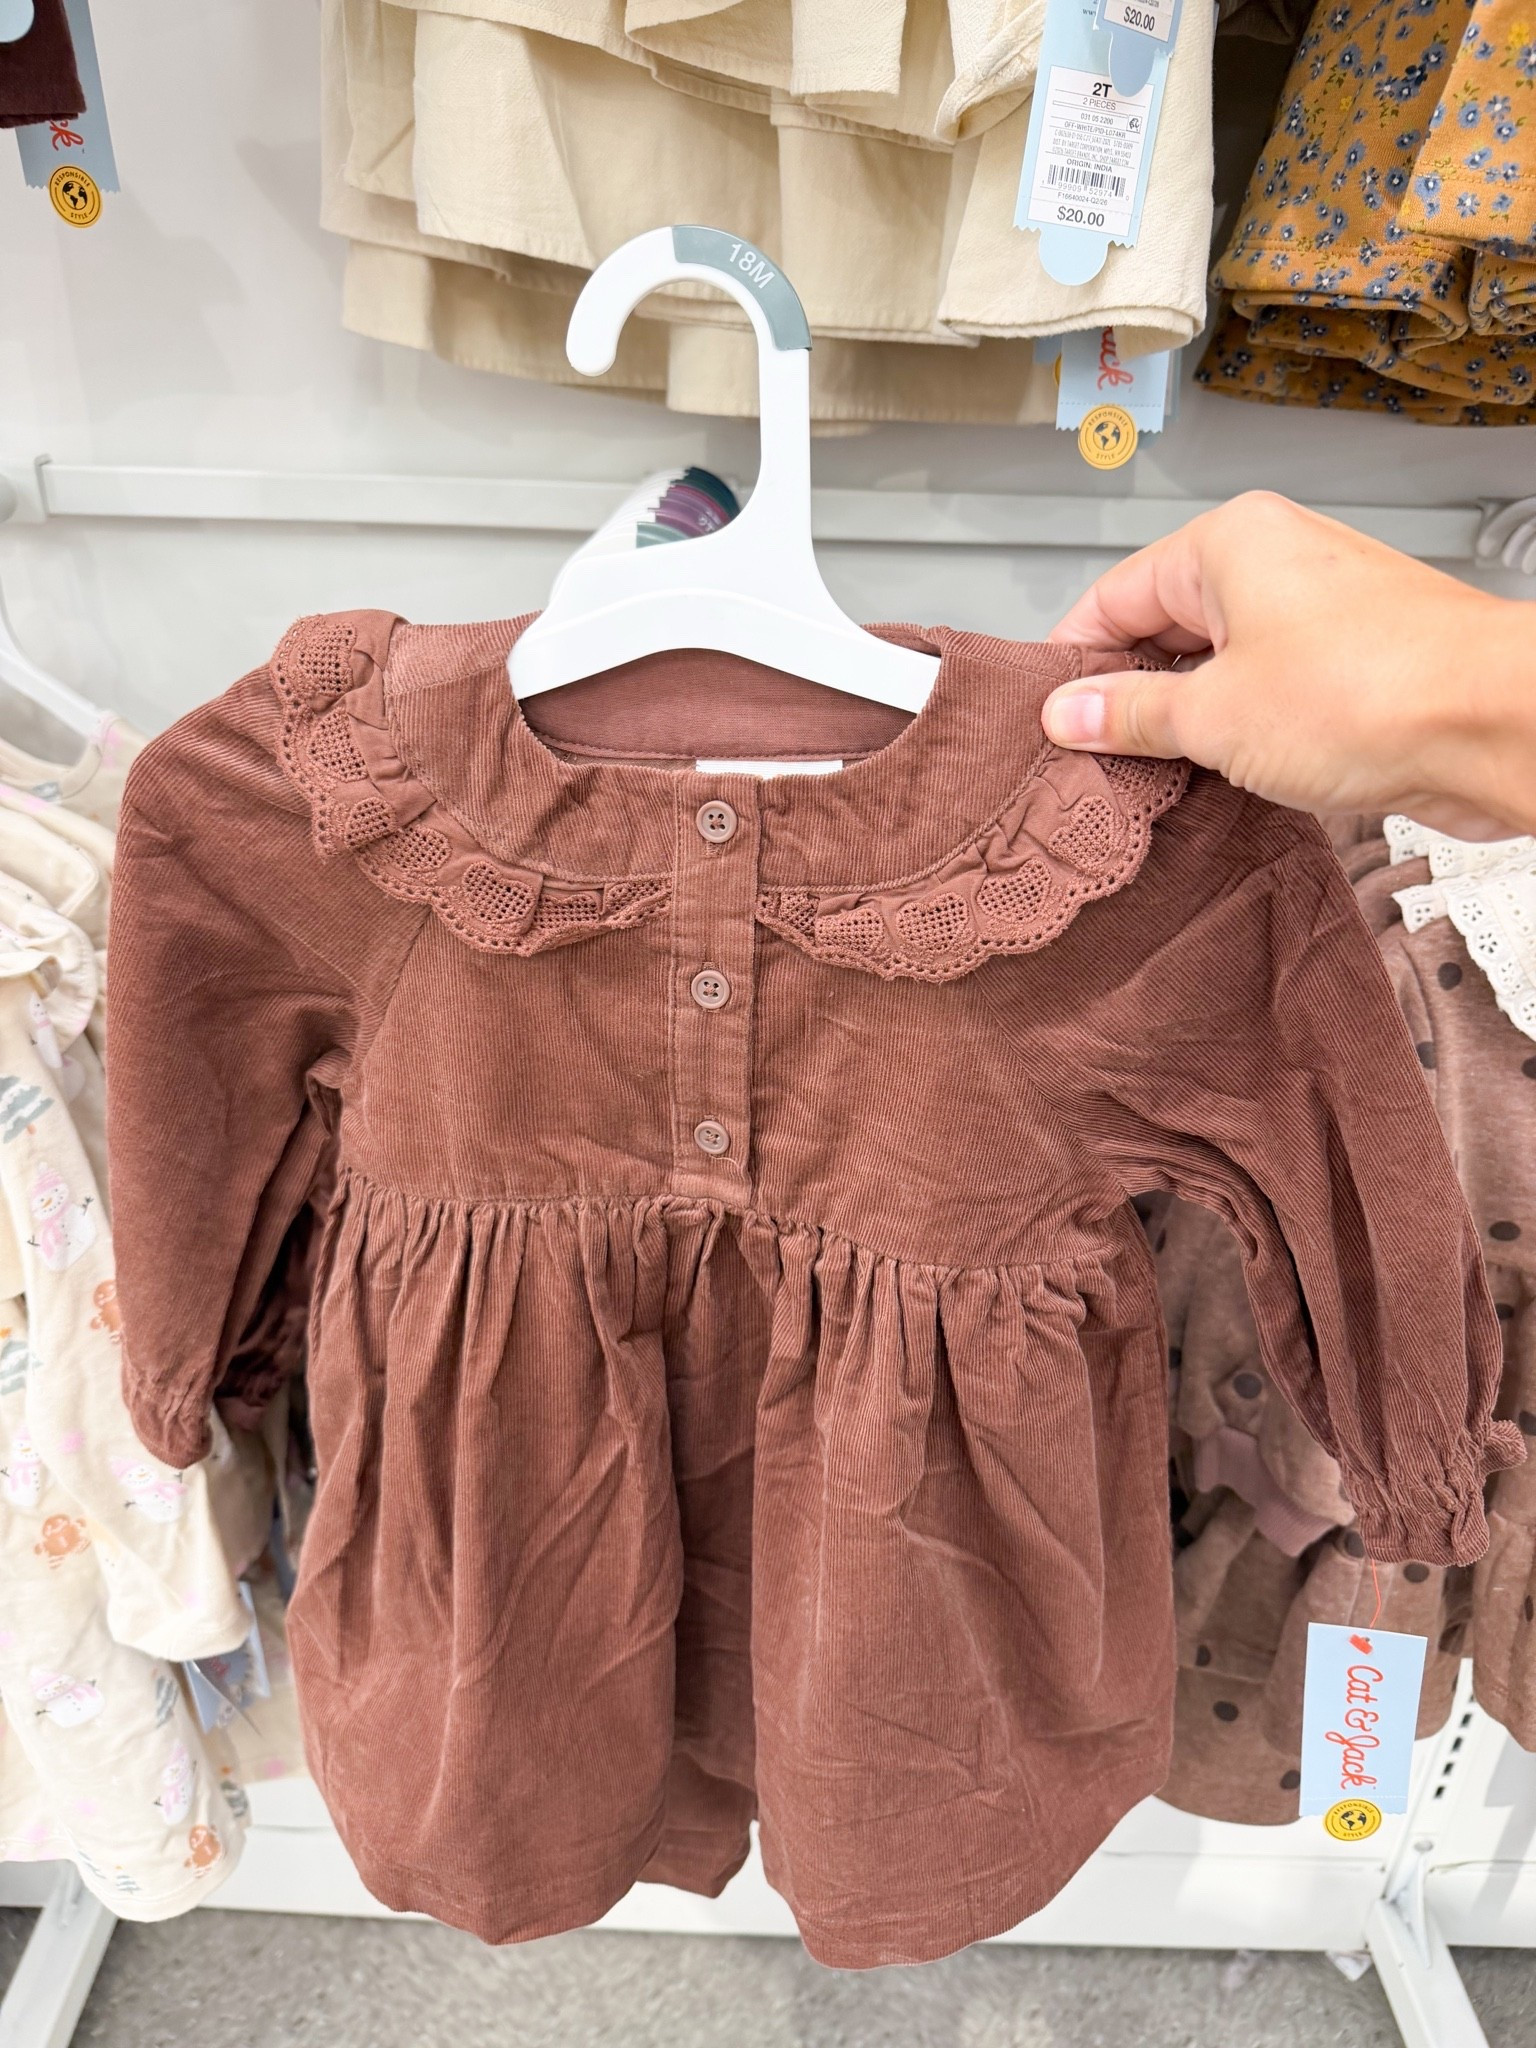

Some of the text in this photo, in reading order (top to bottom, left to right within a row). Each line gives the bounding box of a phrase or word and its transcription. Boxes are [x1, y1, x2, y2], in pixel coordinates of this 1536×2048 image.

[1123, 6, 1156, 32] $20.00
[1092, 82, 1112, 98] 2T
[1082, 97, 1116, 110] 2 PIECES
[1066, 158, 1113, 173] ORIGIN: INDIA
[54, 171, 92, 187] RESPONSIBLE
[70, 212, 89, 220] STYLE
[1056, 205, 1105, 227] $20.00
[729, 242, 776, 290] 18M
[1096, 325, 1135, 391] ack
[1088, 411, 1128, 428] RESPONSIBLE
[1095, 452, 1116, 460] STYLE
[1324, 1664, 1384, 1790] Cat & Jack
